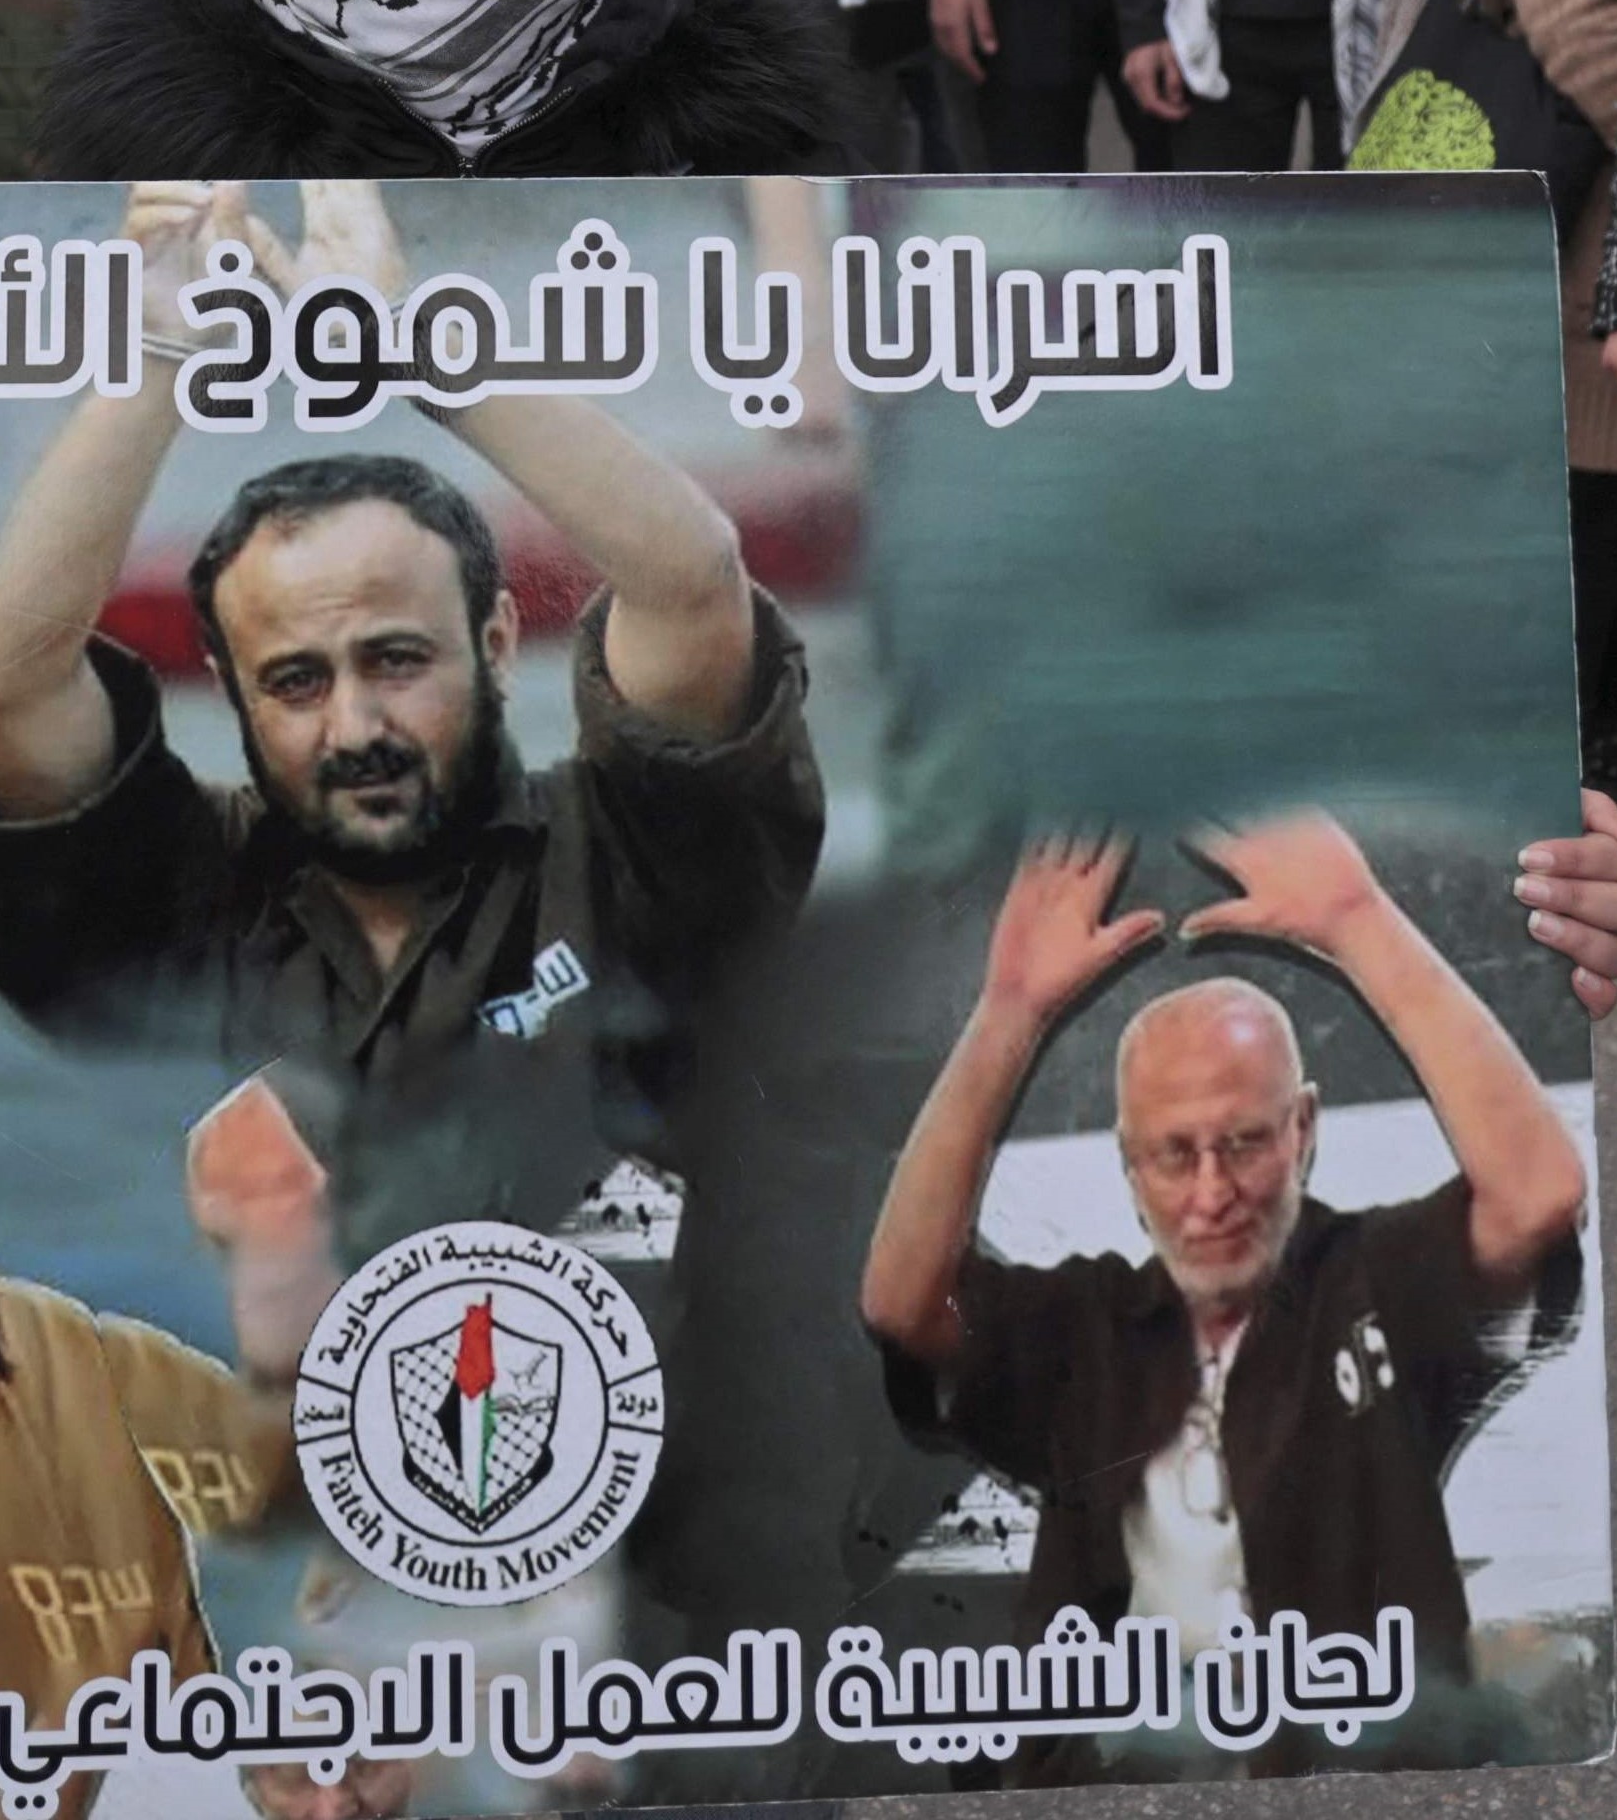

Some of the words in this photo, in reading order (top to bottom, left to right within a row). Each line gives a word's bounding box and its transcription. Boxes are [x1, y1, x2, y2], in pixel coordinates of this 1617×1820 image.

[186, 230, 648, 420] شموخ
[702, 248, 792, 417] يا
[844, 244, 1222, 418] اسرانا
[318, 1245, 433, 1367] الفتحاوية
[440, 1233, 571, 1283] الشبيبة
[570, 1264, 629, 1359] حركة
[319, 1447, 385, 1552] Fateh
[388, 1532, 488, 1592] Youth
[496, 1447, 641, 1591] Movement
[499, 1639, 791, 1768] للعمل
[826, 1615, 1172, 1753] الشبيبة
[1204, 1616, 1404, 1740] لجان
